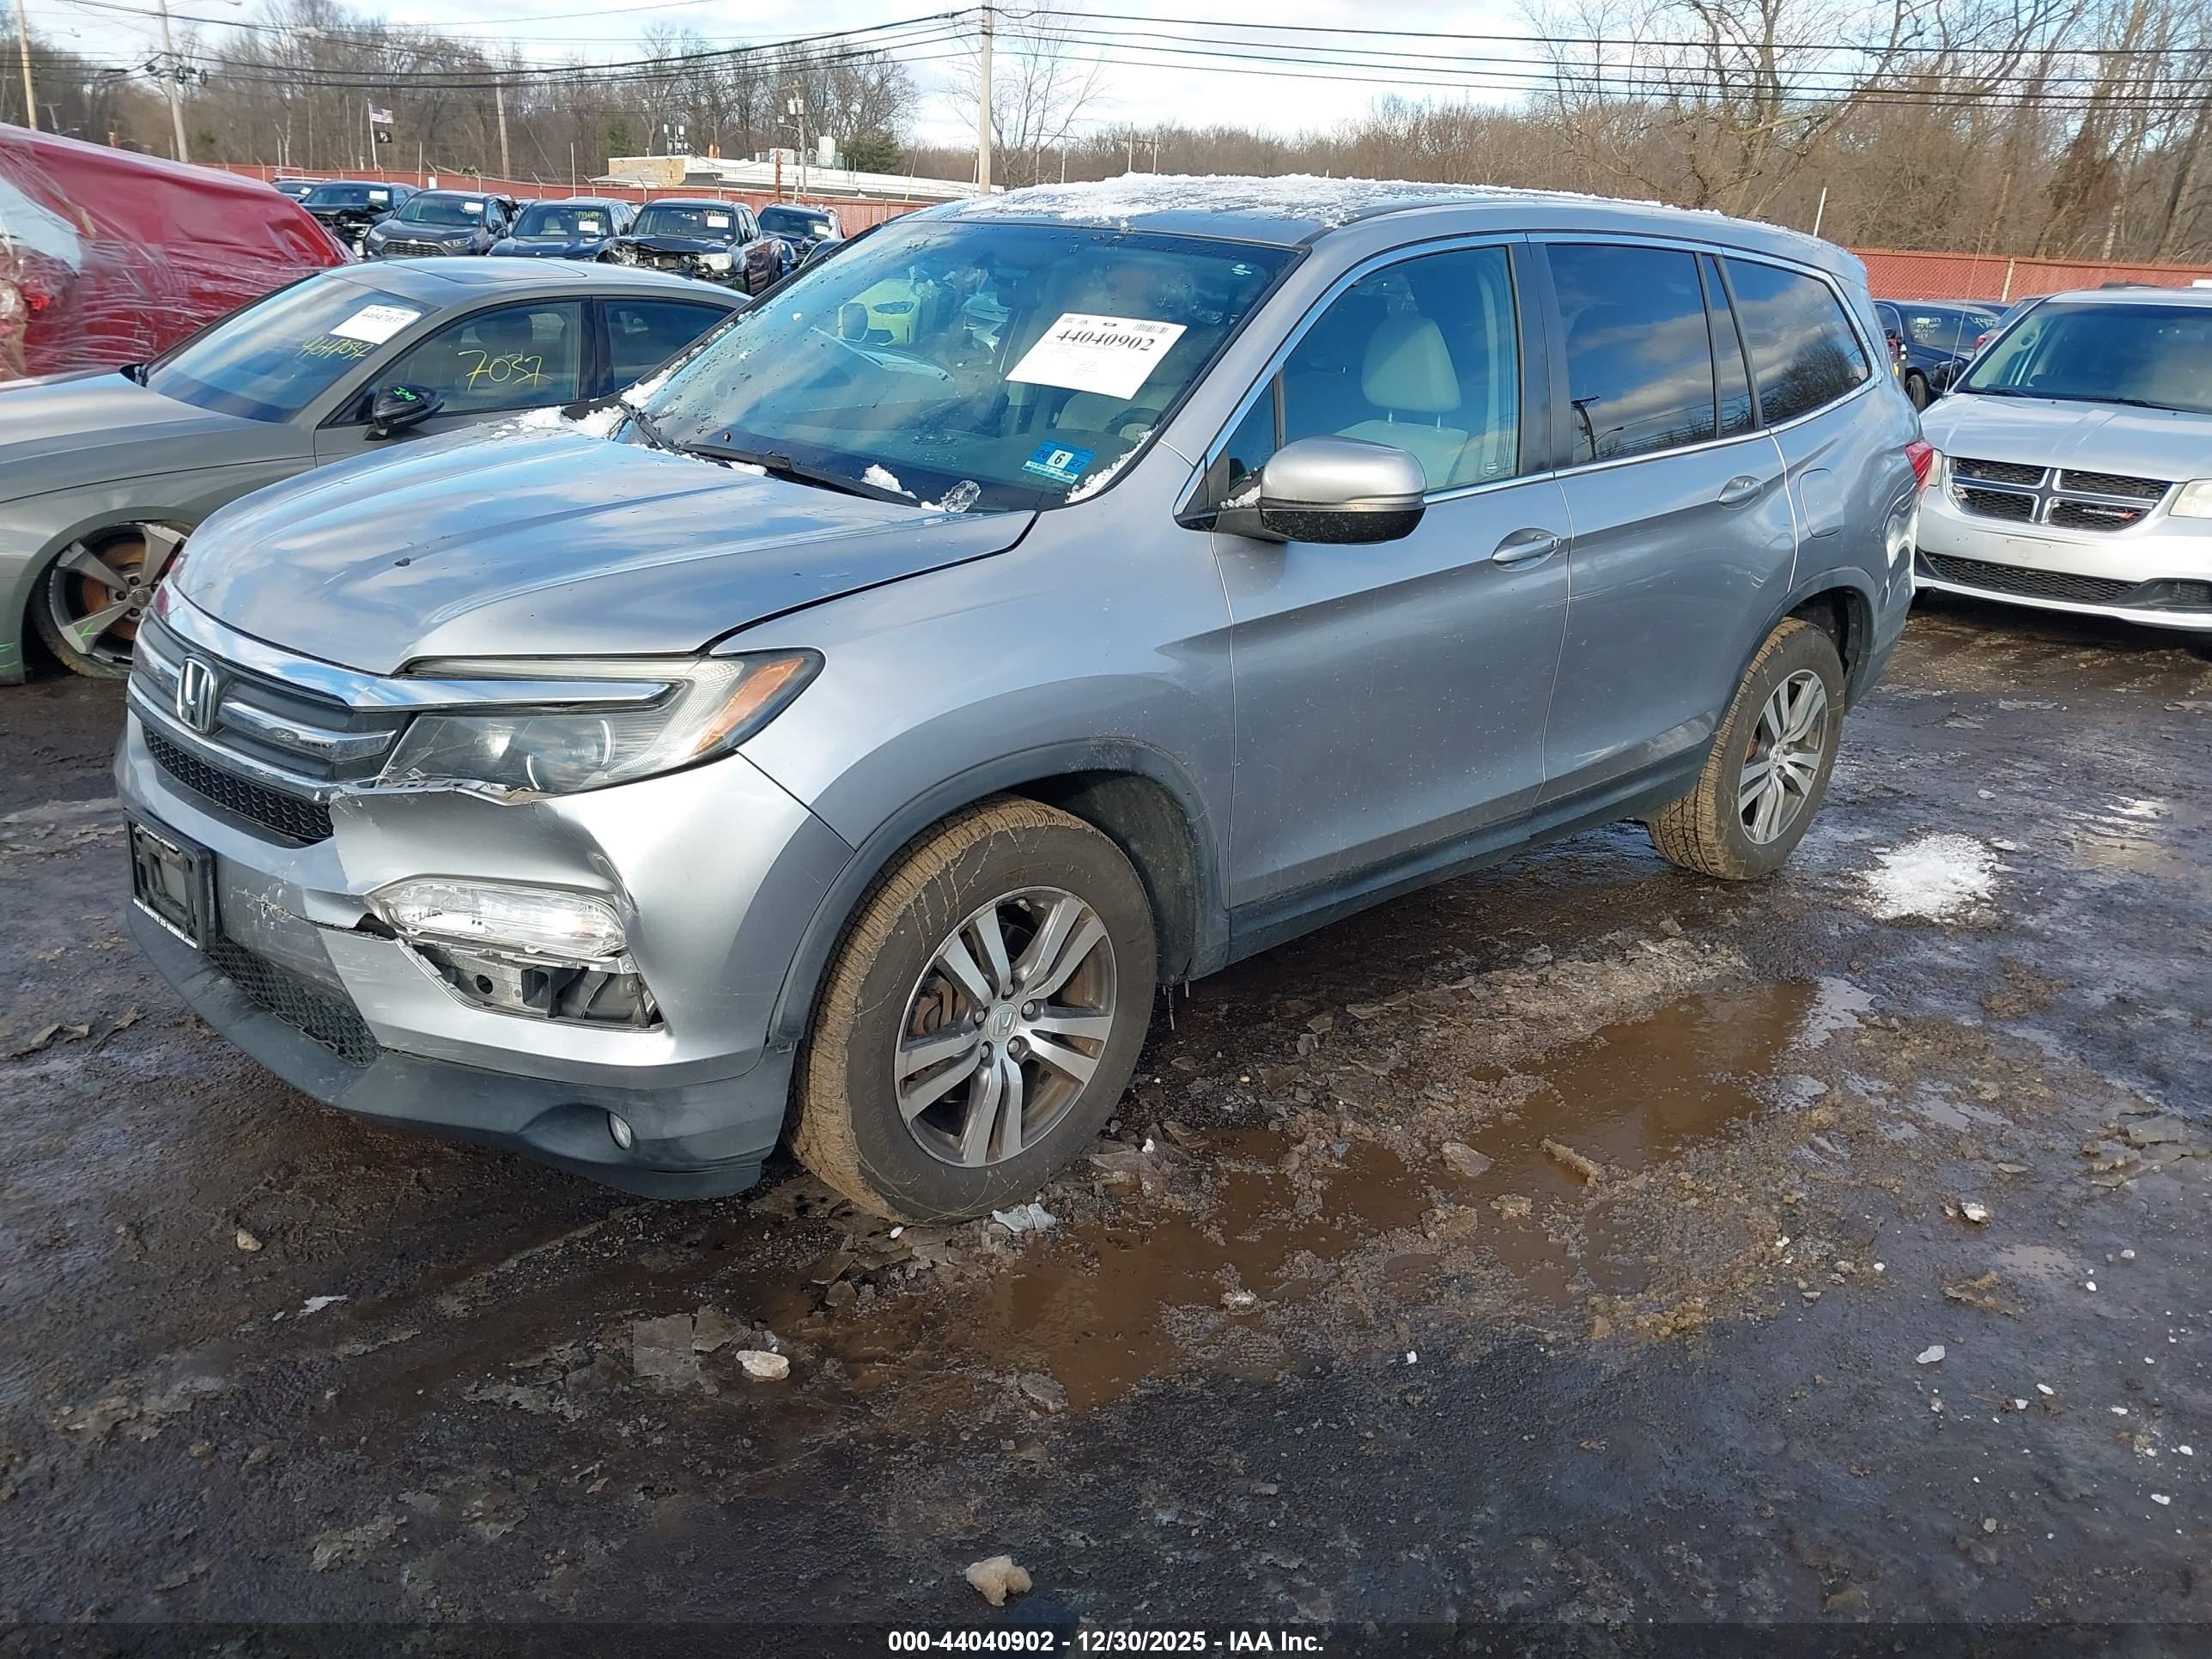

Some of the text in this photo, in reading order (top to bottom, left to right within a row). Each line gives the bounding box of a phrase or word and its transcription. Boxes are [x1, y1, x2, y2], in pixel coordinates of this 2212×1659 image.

[1056, 329, 1156, 351] 44040902
[458, 349, 554, 392] 7037
[1036, 449, 1087, 469] 20 6 27
